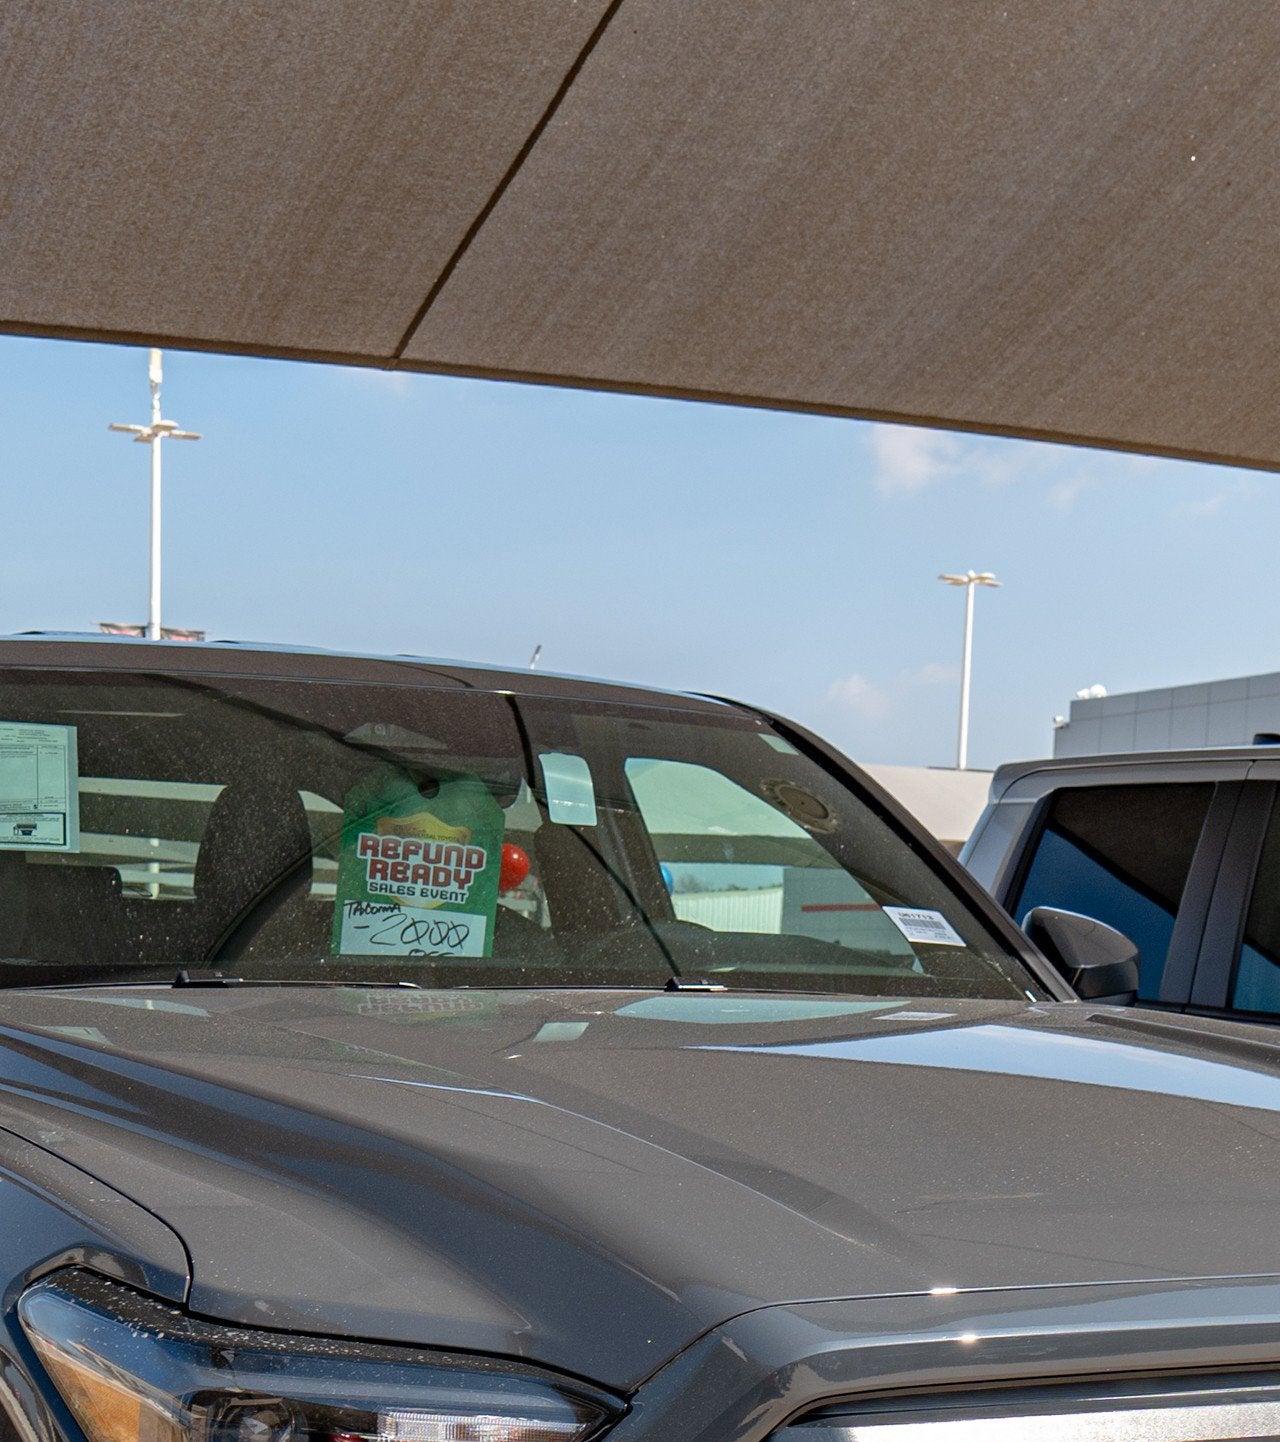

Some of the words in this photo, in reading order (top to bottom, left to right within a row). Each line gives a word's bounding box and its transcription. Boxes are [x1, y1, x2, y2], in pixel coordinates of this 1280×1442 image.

[359, 833, 485, 870] REFUND
[368, 858, 473, 890] READY
[369, 882, 416, 897] SALES
[420, 887, 468, 902] EVENT
